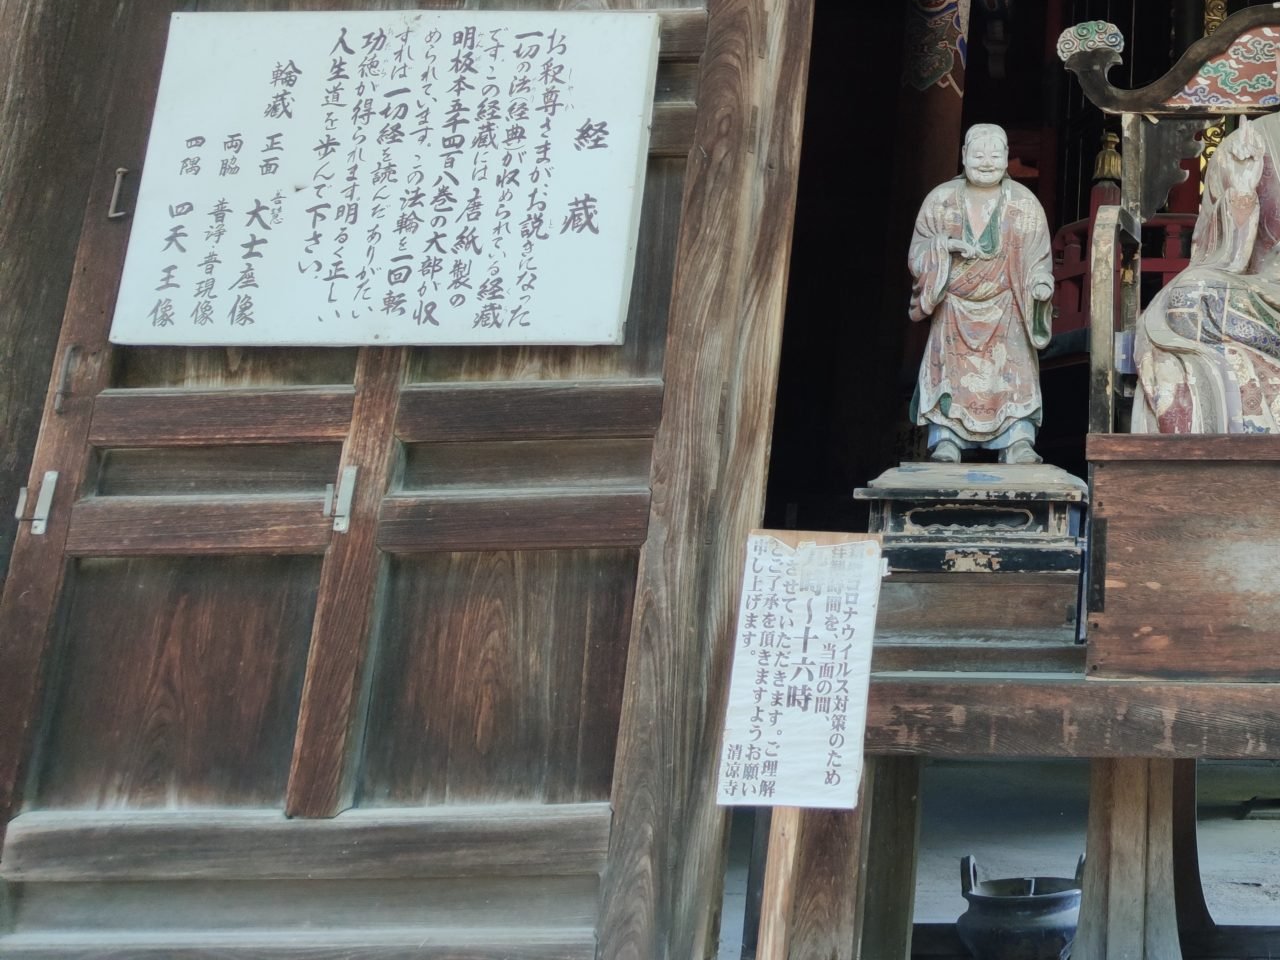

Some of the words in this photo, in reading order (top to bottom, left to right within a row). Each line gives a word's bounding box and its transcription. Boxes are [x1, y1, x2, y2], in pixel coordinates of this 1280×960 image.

[179, 135, 206, 176] 四隅
[218, 132, 244, 177] 両脇
[259, 132, 285, 176] 正面
[146, 200, 195, 328] 四天王像
